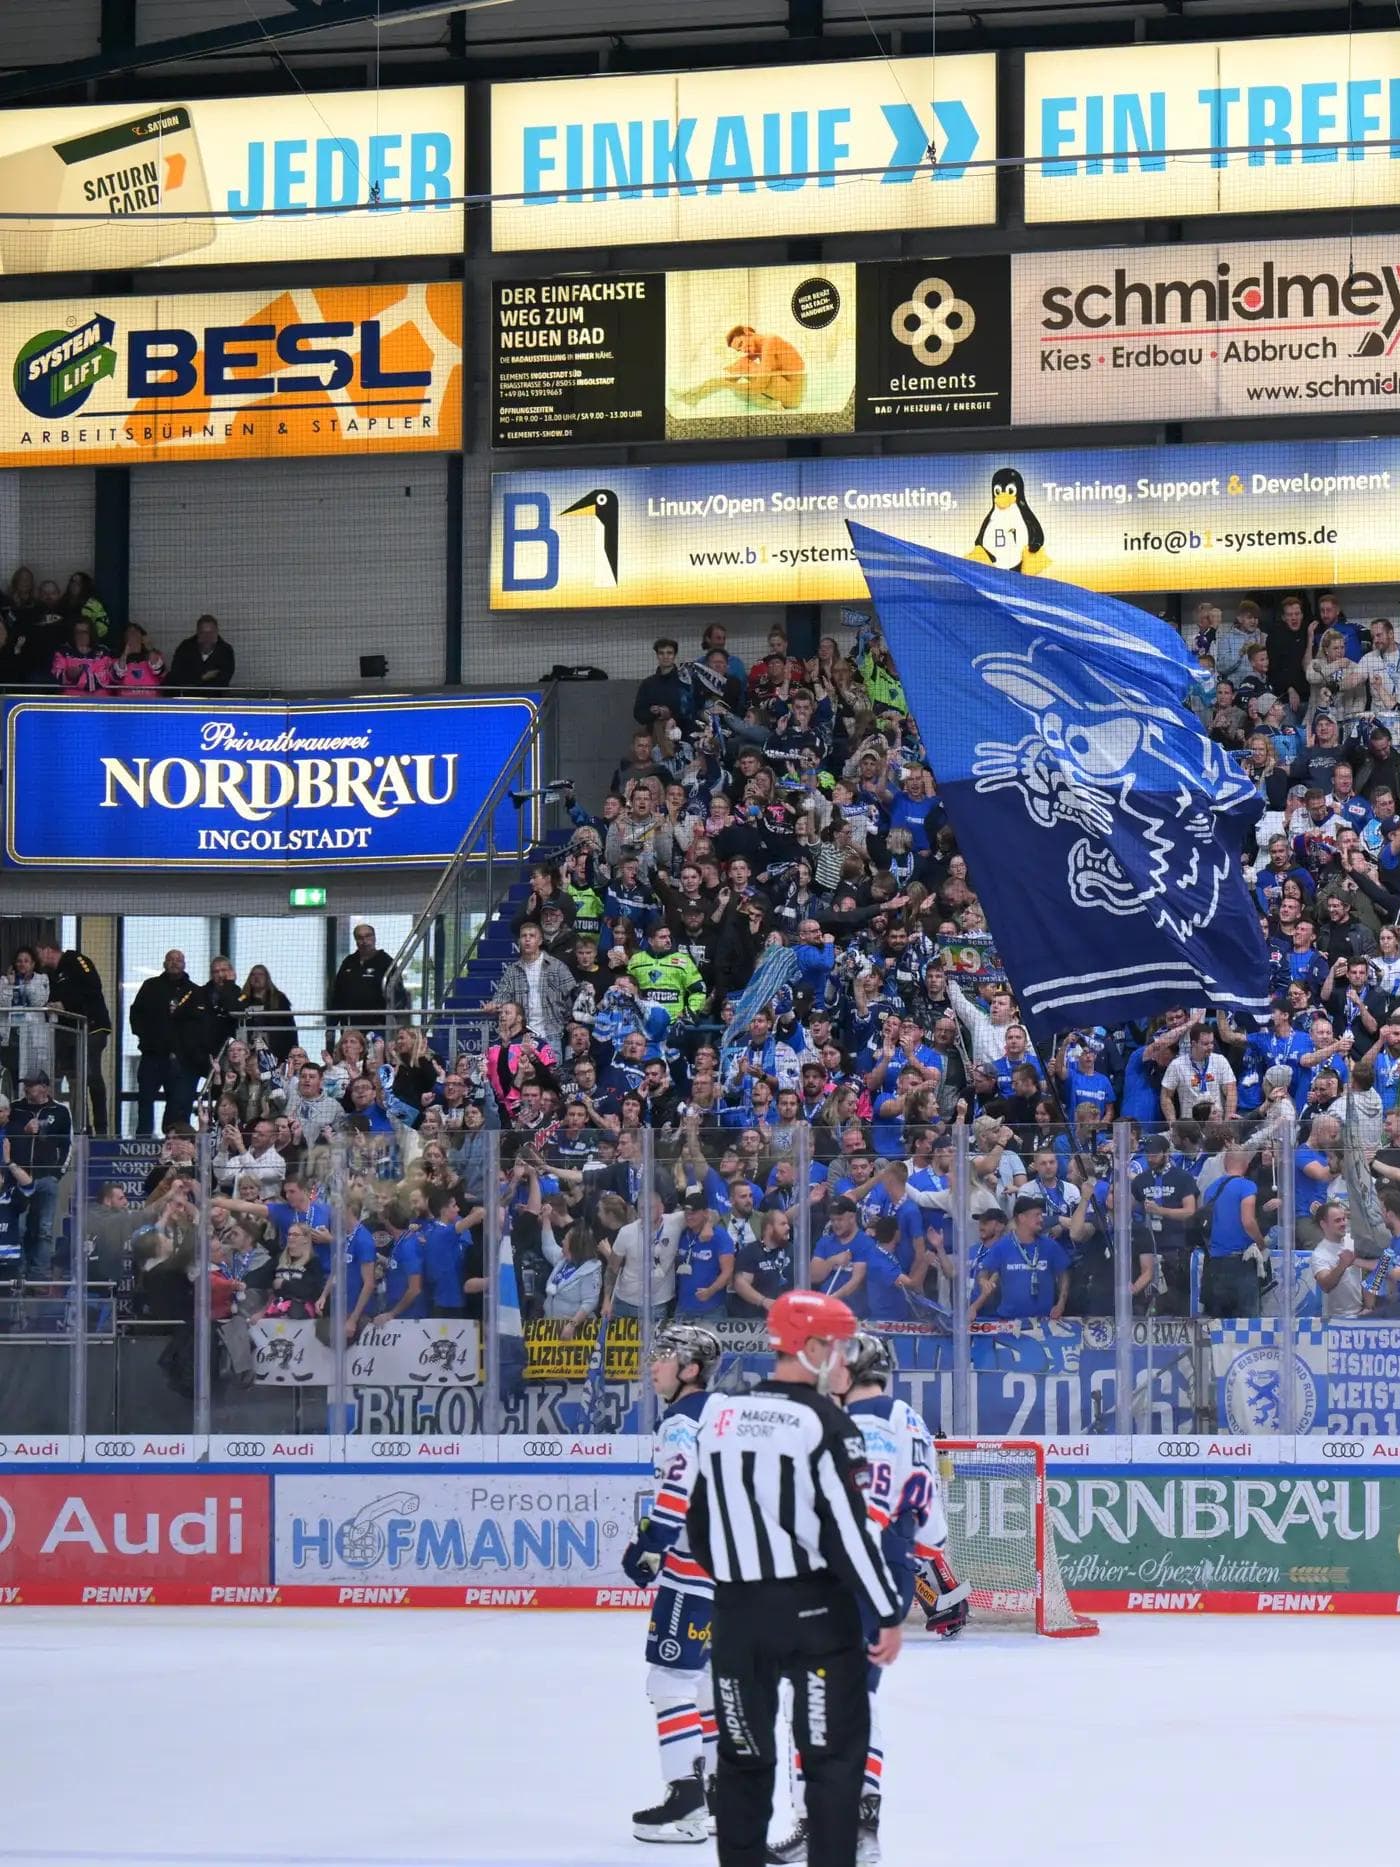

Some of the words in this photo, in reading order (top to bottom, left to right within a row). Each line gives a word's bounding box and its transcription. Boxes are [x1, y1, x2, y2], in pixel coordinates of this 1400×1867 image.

[147, 115, 179, 133] SATURN
[1041, 92, 1166, 177] EIN
[523, 107, 851, 207] EINKAUF
[83, 161, 158, 202] SATURN
[227, 132, 452, 221] JEDER
[109, 184, 160, 215] CARD
[501, 288, 537, 306] DER
[541, 282, 646, 304] EINFACHSTE
[500, 308, 541, 328] WEG
[545, 306, 585, 325] ZUM
[500, 329, 562, 349] NEUEN
[567, 327, 605, 346] BAD
[28, 323, 101, 382] SYSTEM
[127, 320, 432, 398] BESL
[1040, 345, 1092, 371] Kies
[1111, 343, 1203, 369] Erdbau
[1223, 339, 1338, 363] Abbruch
[63, 356, 103, 394] LIFT
[890, 373, 976, 392] elements
[875, 406, 893, 414] BAD
[903, 403, 943, 412] HEIZUNG
[953, 401, 992, 411] ENERGIE
[20, 421, 256, 445] ARBEITSBÜHNEN
[277, 421, 288, 435] &
[311, 415, 432, 433] STAPLER
[1043, 480, 1133, 504] Training,
[1137, 477, 1220, 503] Support
[1227, 475, 1245, 495] &
[1252, 471, 1391, 498] Development
[647, 492, 764, 518] Linux/Open
[771, 492, 838, 512] Source
[843, 487, 958, 512] Consulting,
[1124, 525, 1338, 553] info@b1-systems.de
[200, 721, 373, 754] Privatbrauerei
[100, 753, 459, 821] NORDBRÄU
[198, 826, 372, 851] INGOLSTADT
[351, 1357, 374, 1376] 64
[736, 1423, 776, 1438] SPORT
[740, 1409, 801, 1429] MAGENTA
[15, 1442, 59, 1457] Audi
[143, 1442, 186, 1457] Audi
[272, 1442, 315, 1457] Audi
[418, 1442, 461, 1457] Audi
[570, 1442, 613, 1457] Audi
[1047, 1443, 1090, 1457] Audi
[1208, 1443, 1252, 1457] Audi
[471, 1488, 599, 1512] Personal
[39, 1496, 243, 1556] Audi
[292, 1516, 601, 1570] HOFMANN
[719, 1676, 752, 1756] LINDNER
